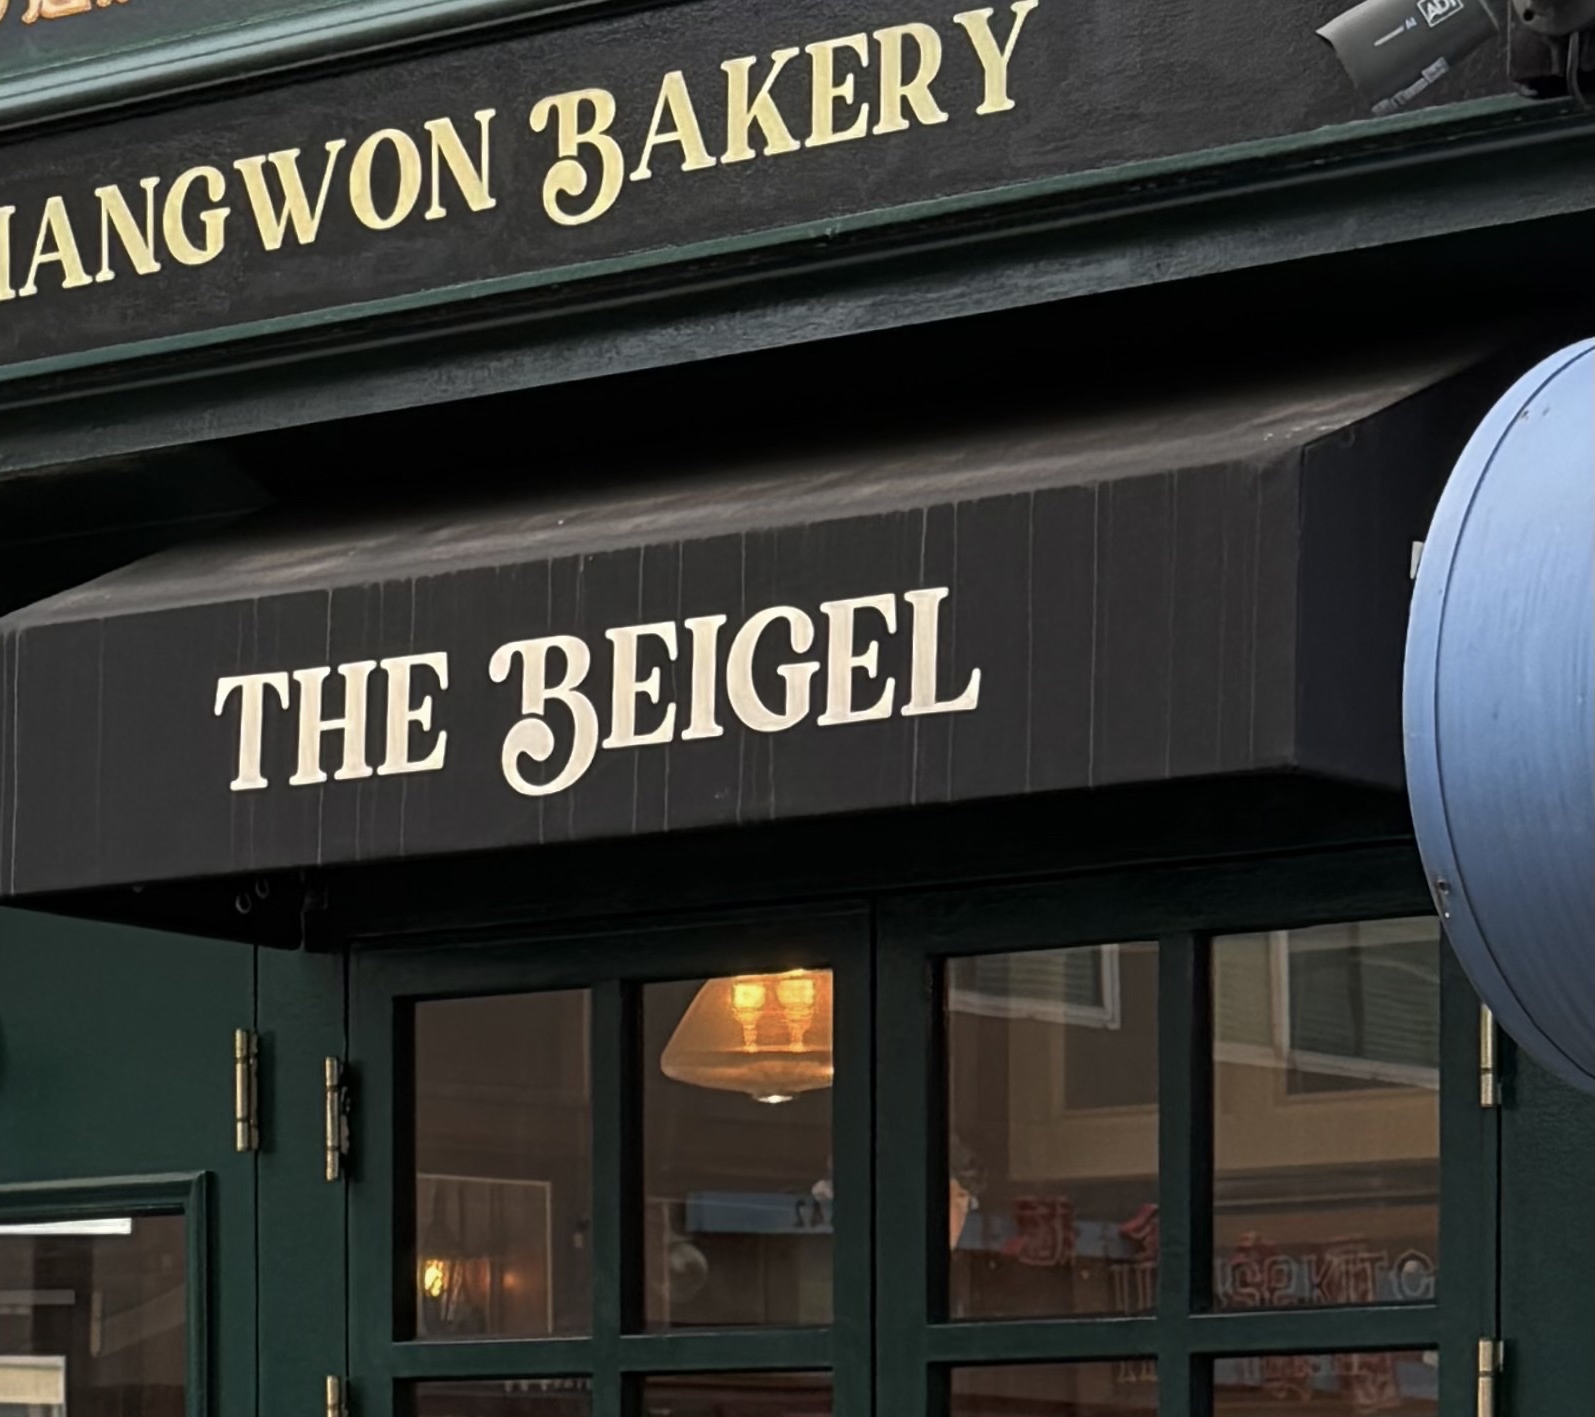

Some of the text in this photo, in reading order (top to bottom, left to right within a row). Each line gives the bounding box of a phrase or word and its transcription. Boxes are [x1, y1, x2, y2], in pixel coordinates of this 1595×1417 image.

[529, 0, 1039, 226] BAKERY
[213, 586, 982, 796] THE BEIGEL
